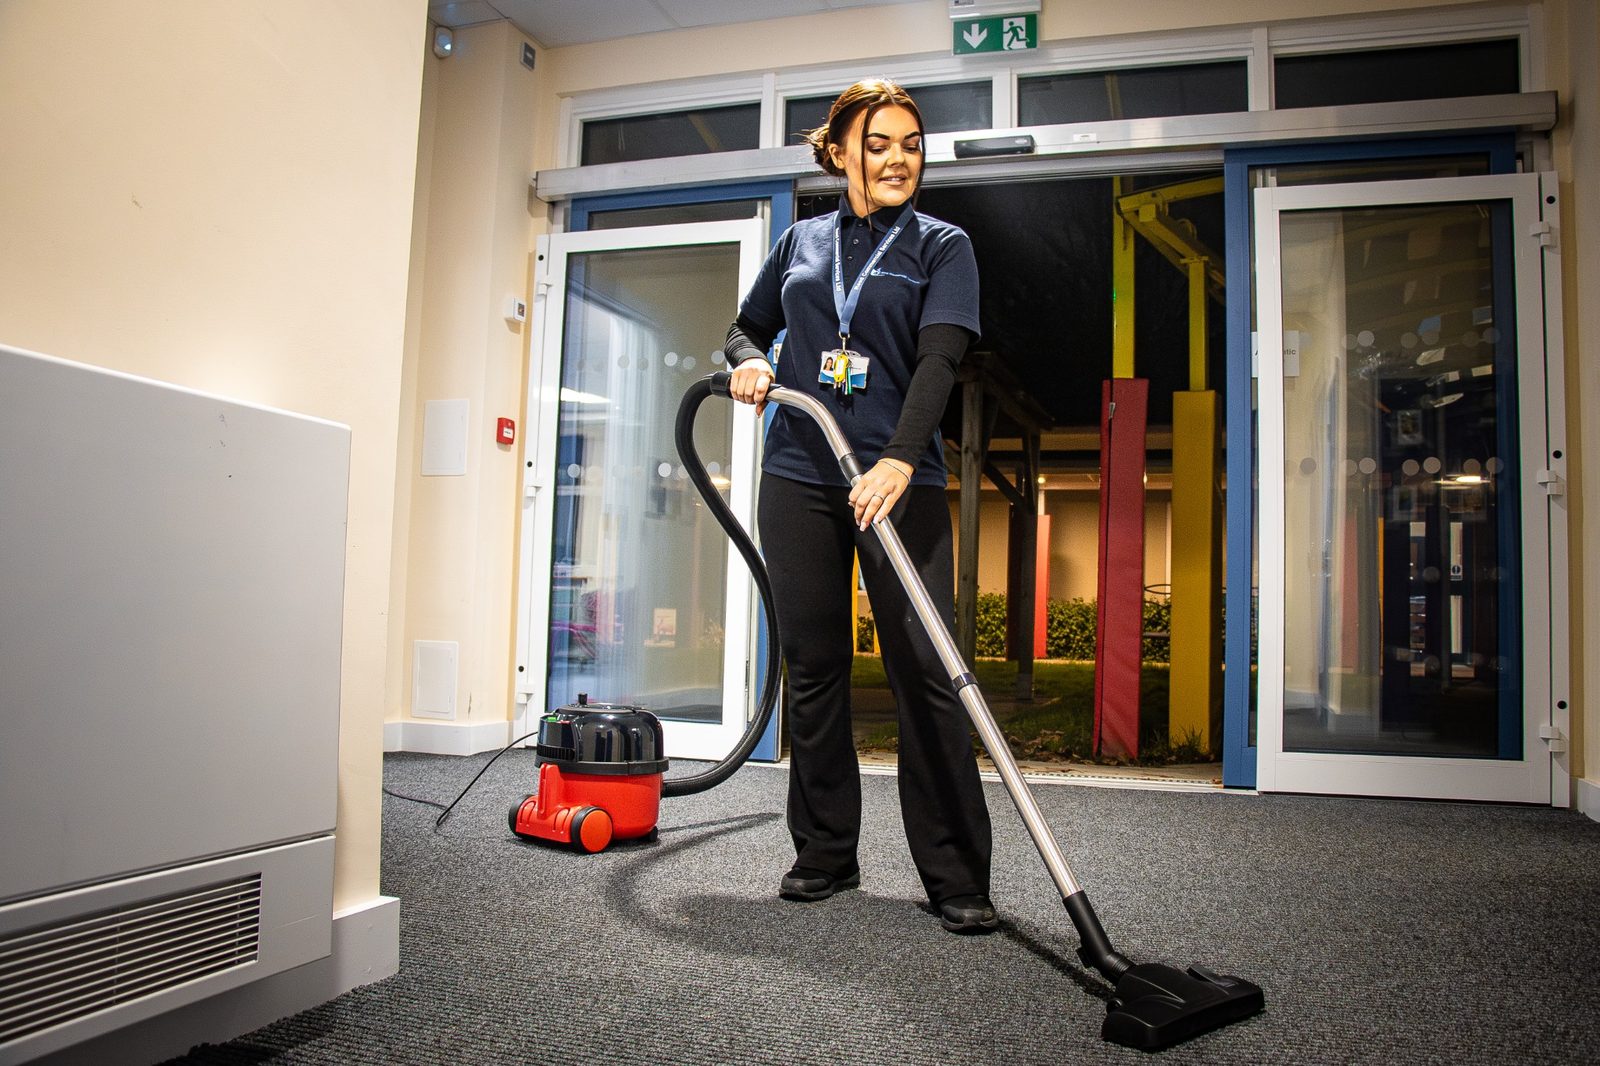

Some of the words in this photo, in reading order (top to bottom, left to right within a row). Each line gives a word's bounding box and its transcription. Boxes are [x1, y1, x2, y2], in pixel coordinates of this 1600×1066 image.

[861, 250, 883, 277] Commercial
[879, 232, 896, 251] Services
[891, 225, 901, 234] Ltd
